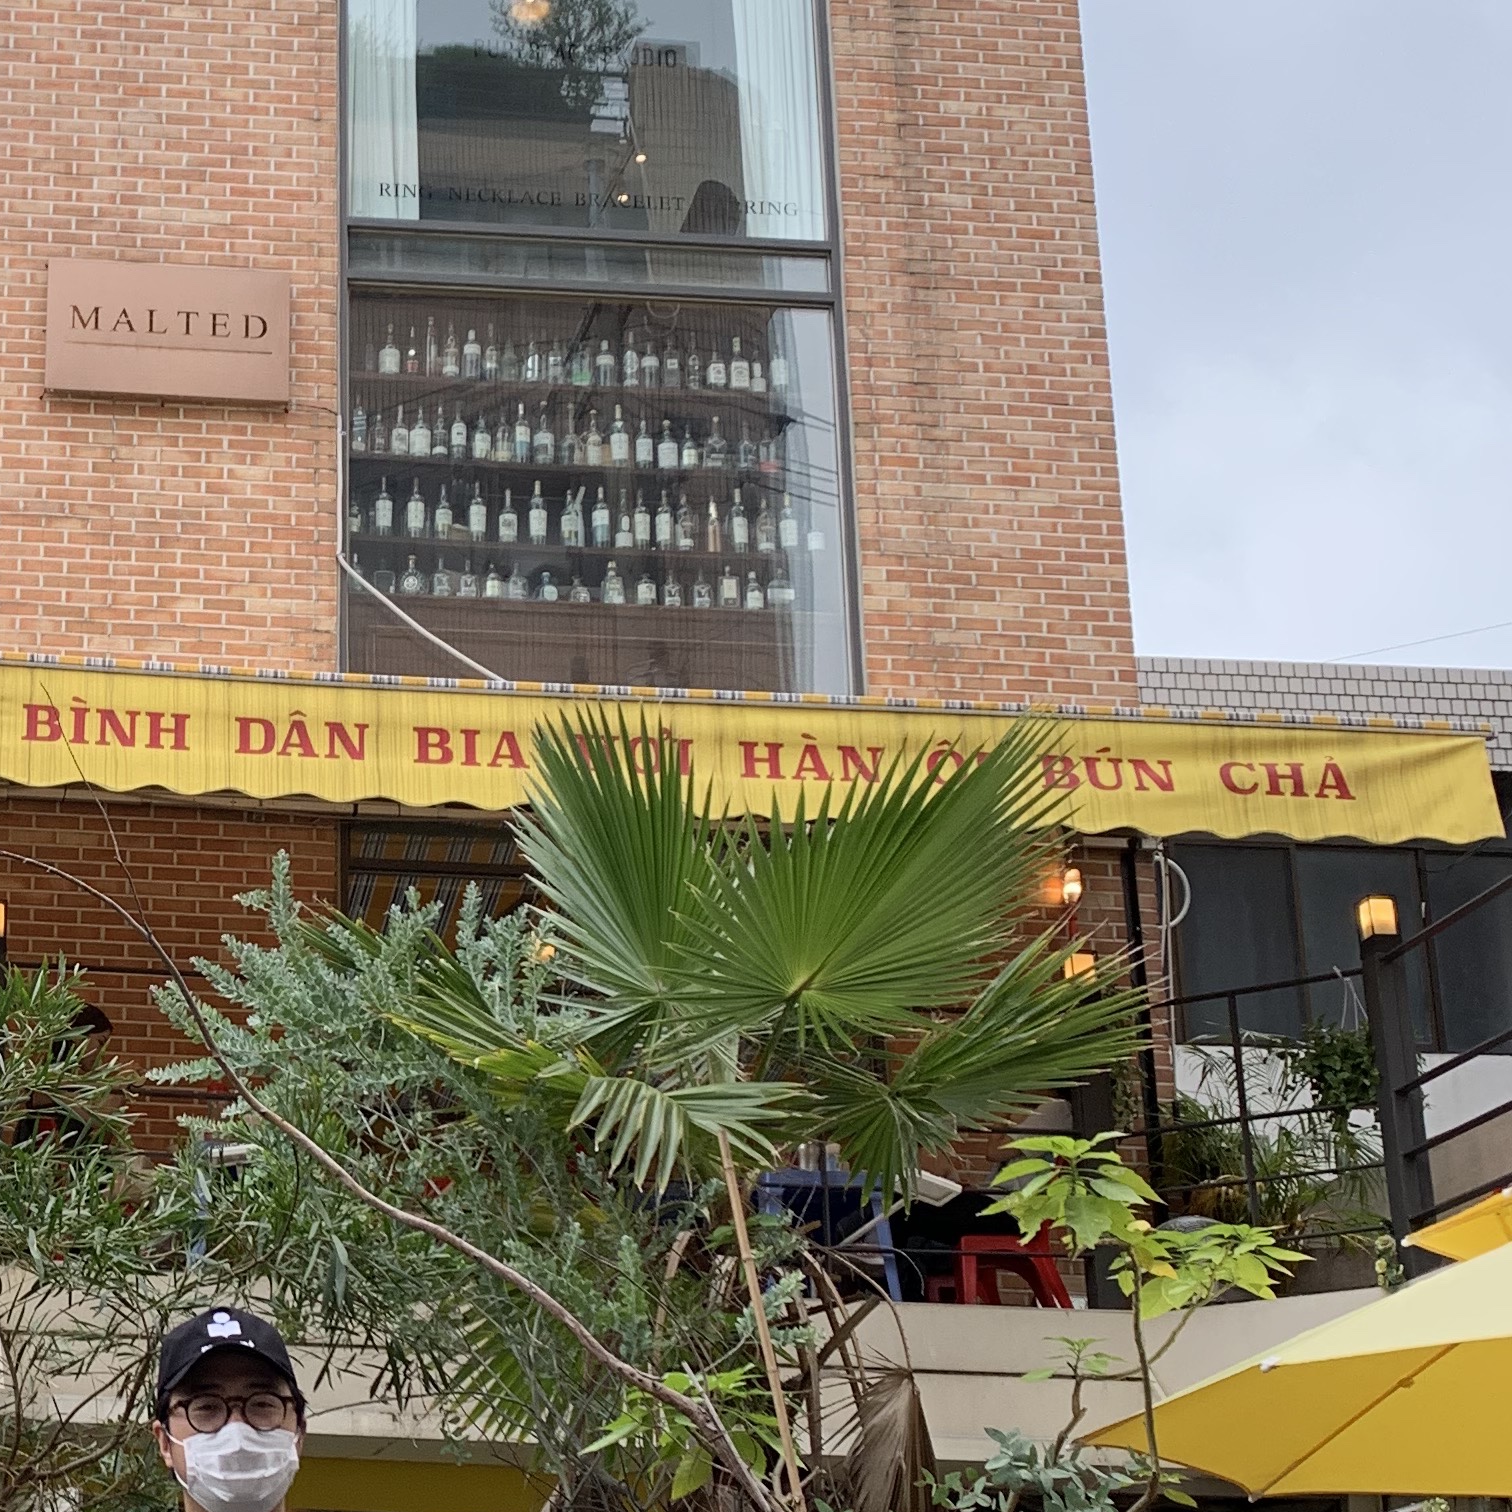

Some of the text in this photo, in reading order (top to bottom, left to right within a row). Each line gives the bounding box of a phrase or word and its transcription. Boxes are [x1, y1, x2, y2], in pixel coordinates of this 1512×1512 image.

[378, 181, 433, 199] RING
[68, 303, 269, 339] MALTED
[21, 696, 192, 752] BÌNH
[234, 710, 370, 762] DÂN
[412, 726, 530, 770] BIA
[739, 733, 884, 783] HÀN
[1038, 746, 1175, 793] BÚN
[1219, 755, 1356, 801] CHẢ
